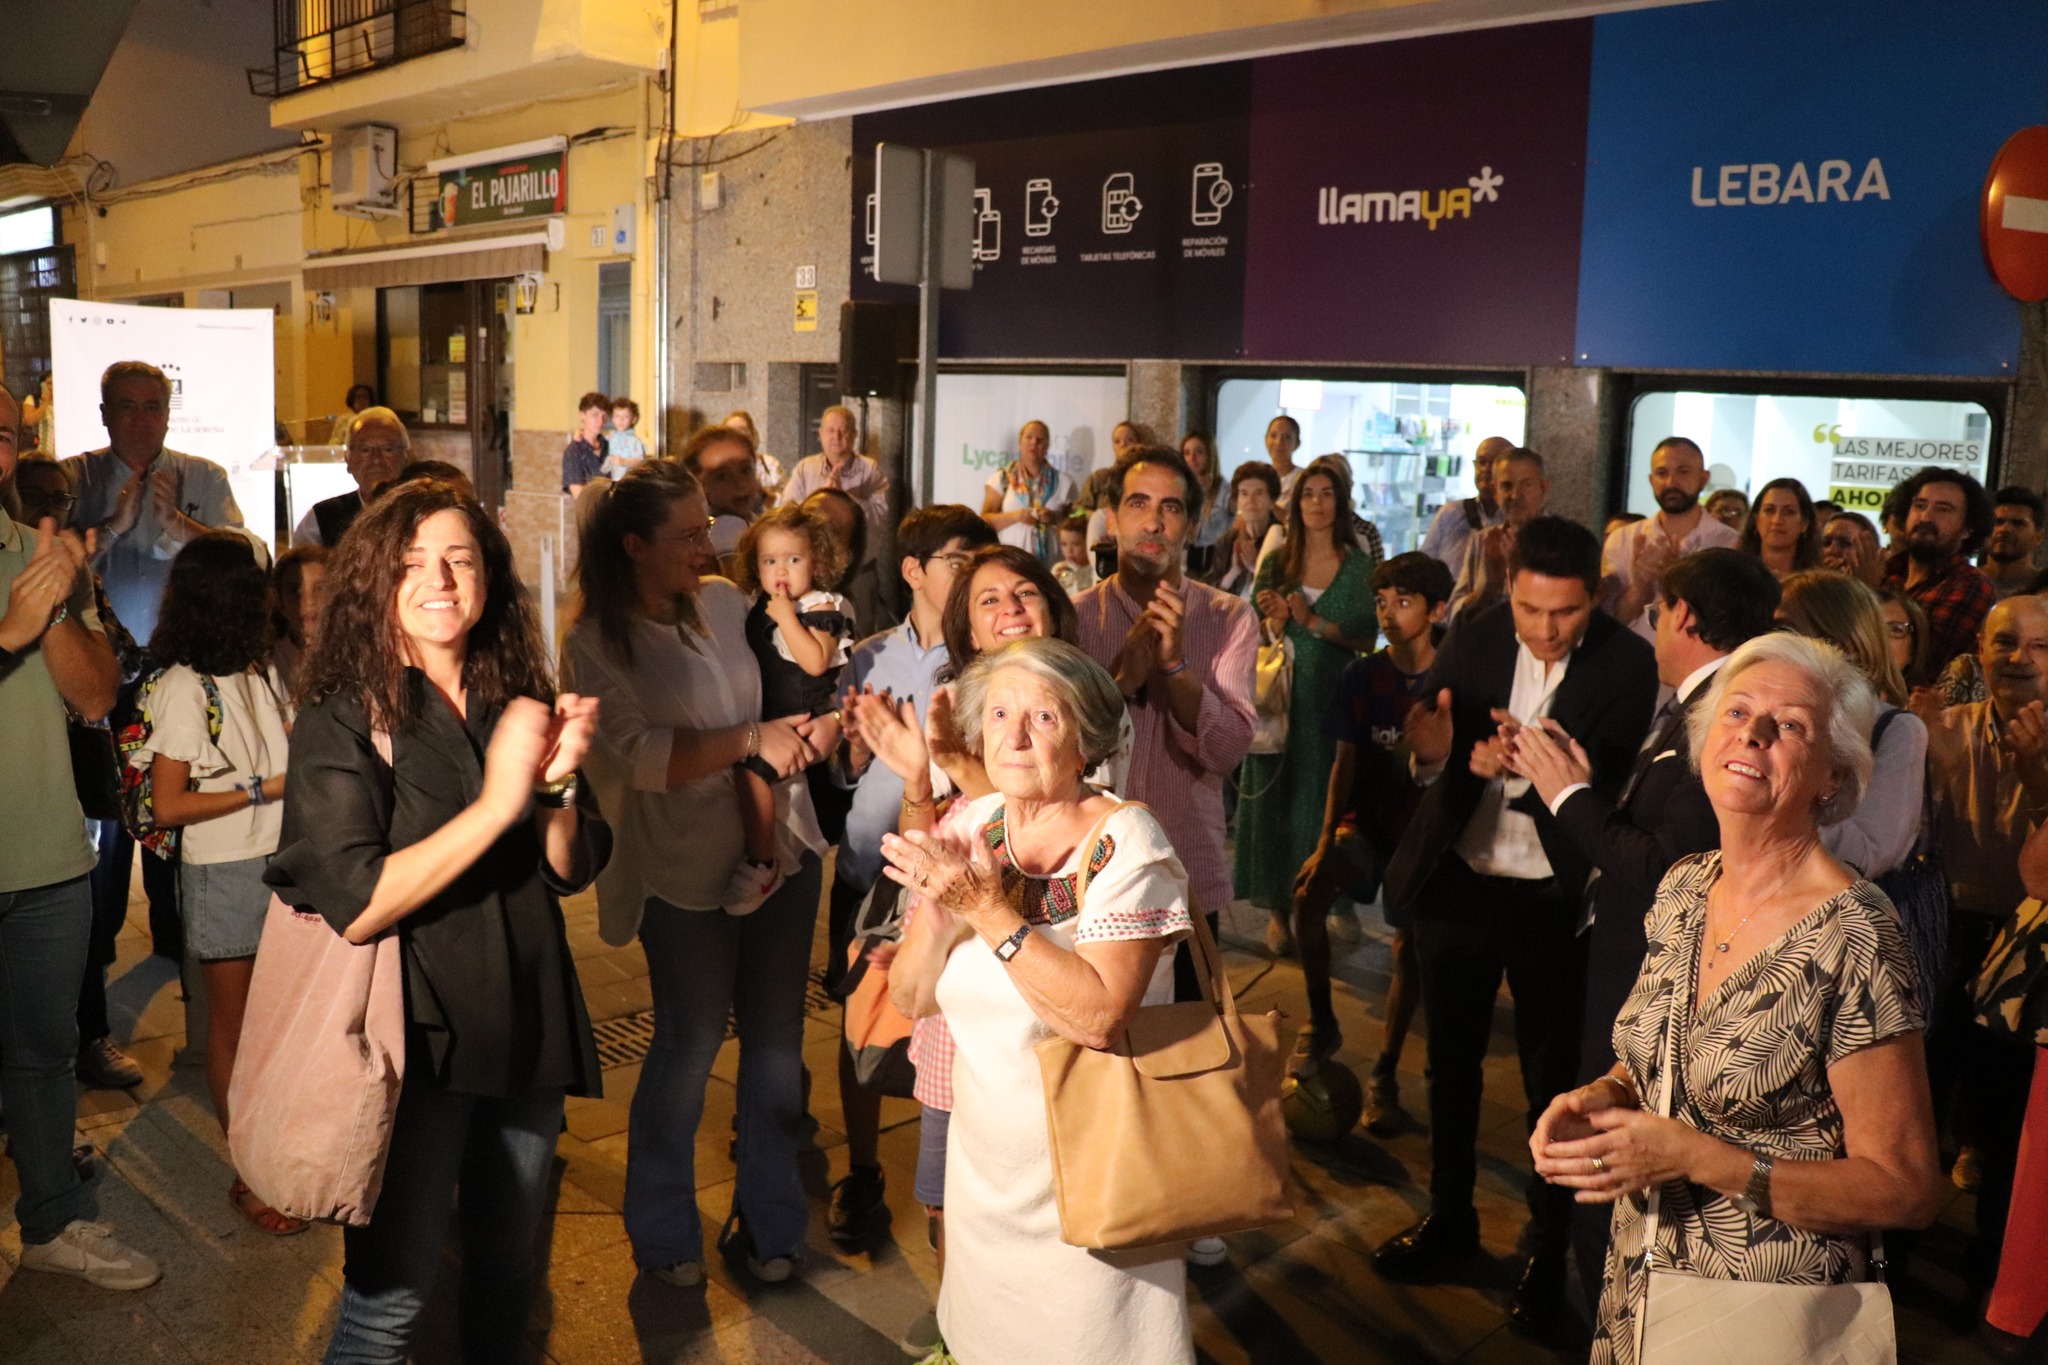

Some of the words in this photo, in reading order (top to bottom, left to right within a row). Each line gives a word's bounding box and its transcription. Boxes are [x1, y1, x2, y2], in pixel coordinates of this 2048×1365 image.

[472, 182, 486, 209] EL
[490, 168, 559, 206] PAJARILLO
[1691, 157, 1891, 207] LEBARA
[1080, 252, 1112, 262] TARJETAS
[800, 268, 814, 286] 33
[1836, 440, 1869, 456] LAS
[1876, 441, 1979, 461] MEJORES
[1834, 463, 1913, 483] TARIFAS
